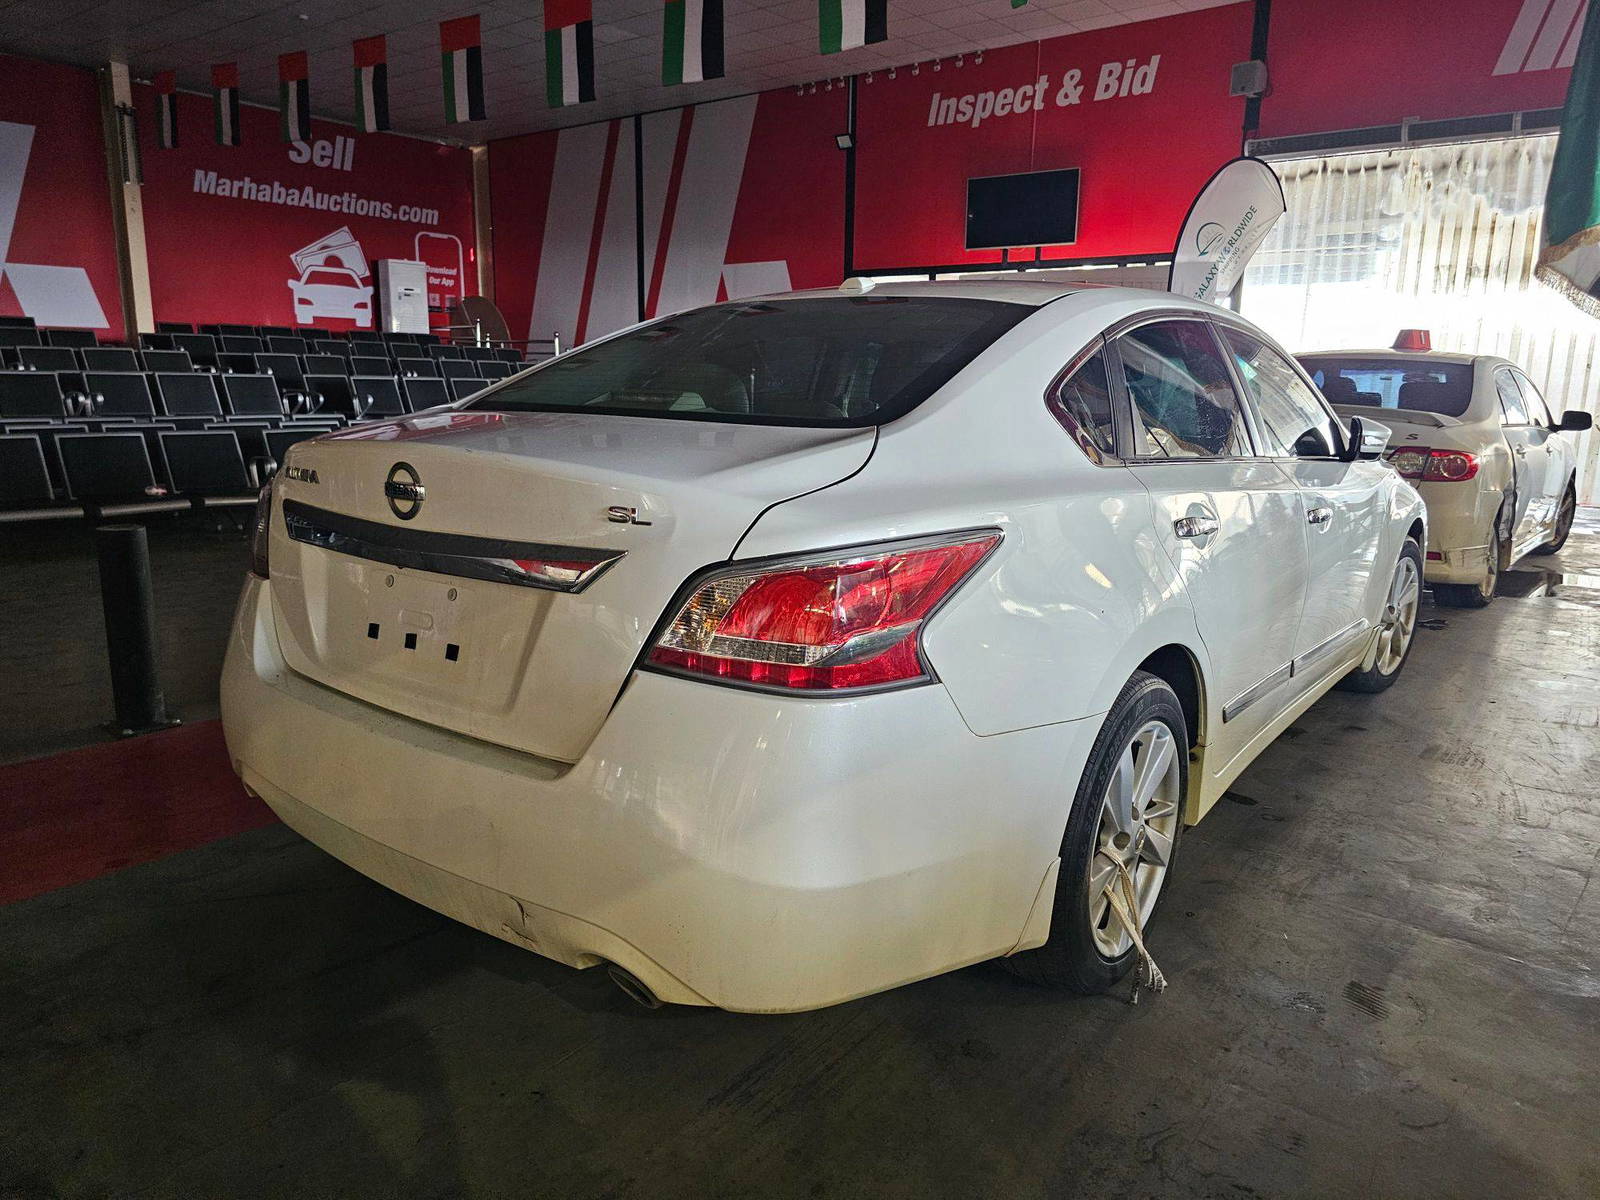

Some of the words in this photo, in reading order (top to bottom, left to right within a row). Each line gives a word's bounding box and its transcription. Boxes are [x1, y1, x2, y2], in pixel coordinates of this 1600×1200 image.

[927, 74, 1049, 128] Inspect
[1055, 68, 1085, 107] &
[1093, 54, 1161, 101] Bid
[288, 135, 356, 172] Sell
[193, 169, 439, 225] MarhabaAuctions.com
[426, 265, 457, 276] Download
[429, 276, 441, 286] Our
[441, 277, 455, 287] App
[607, 506, 652, 526] SL
